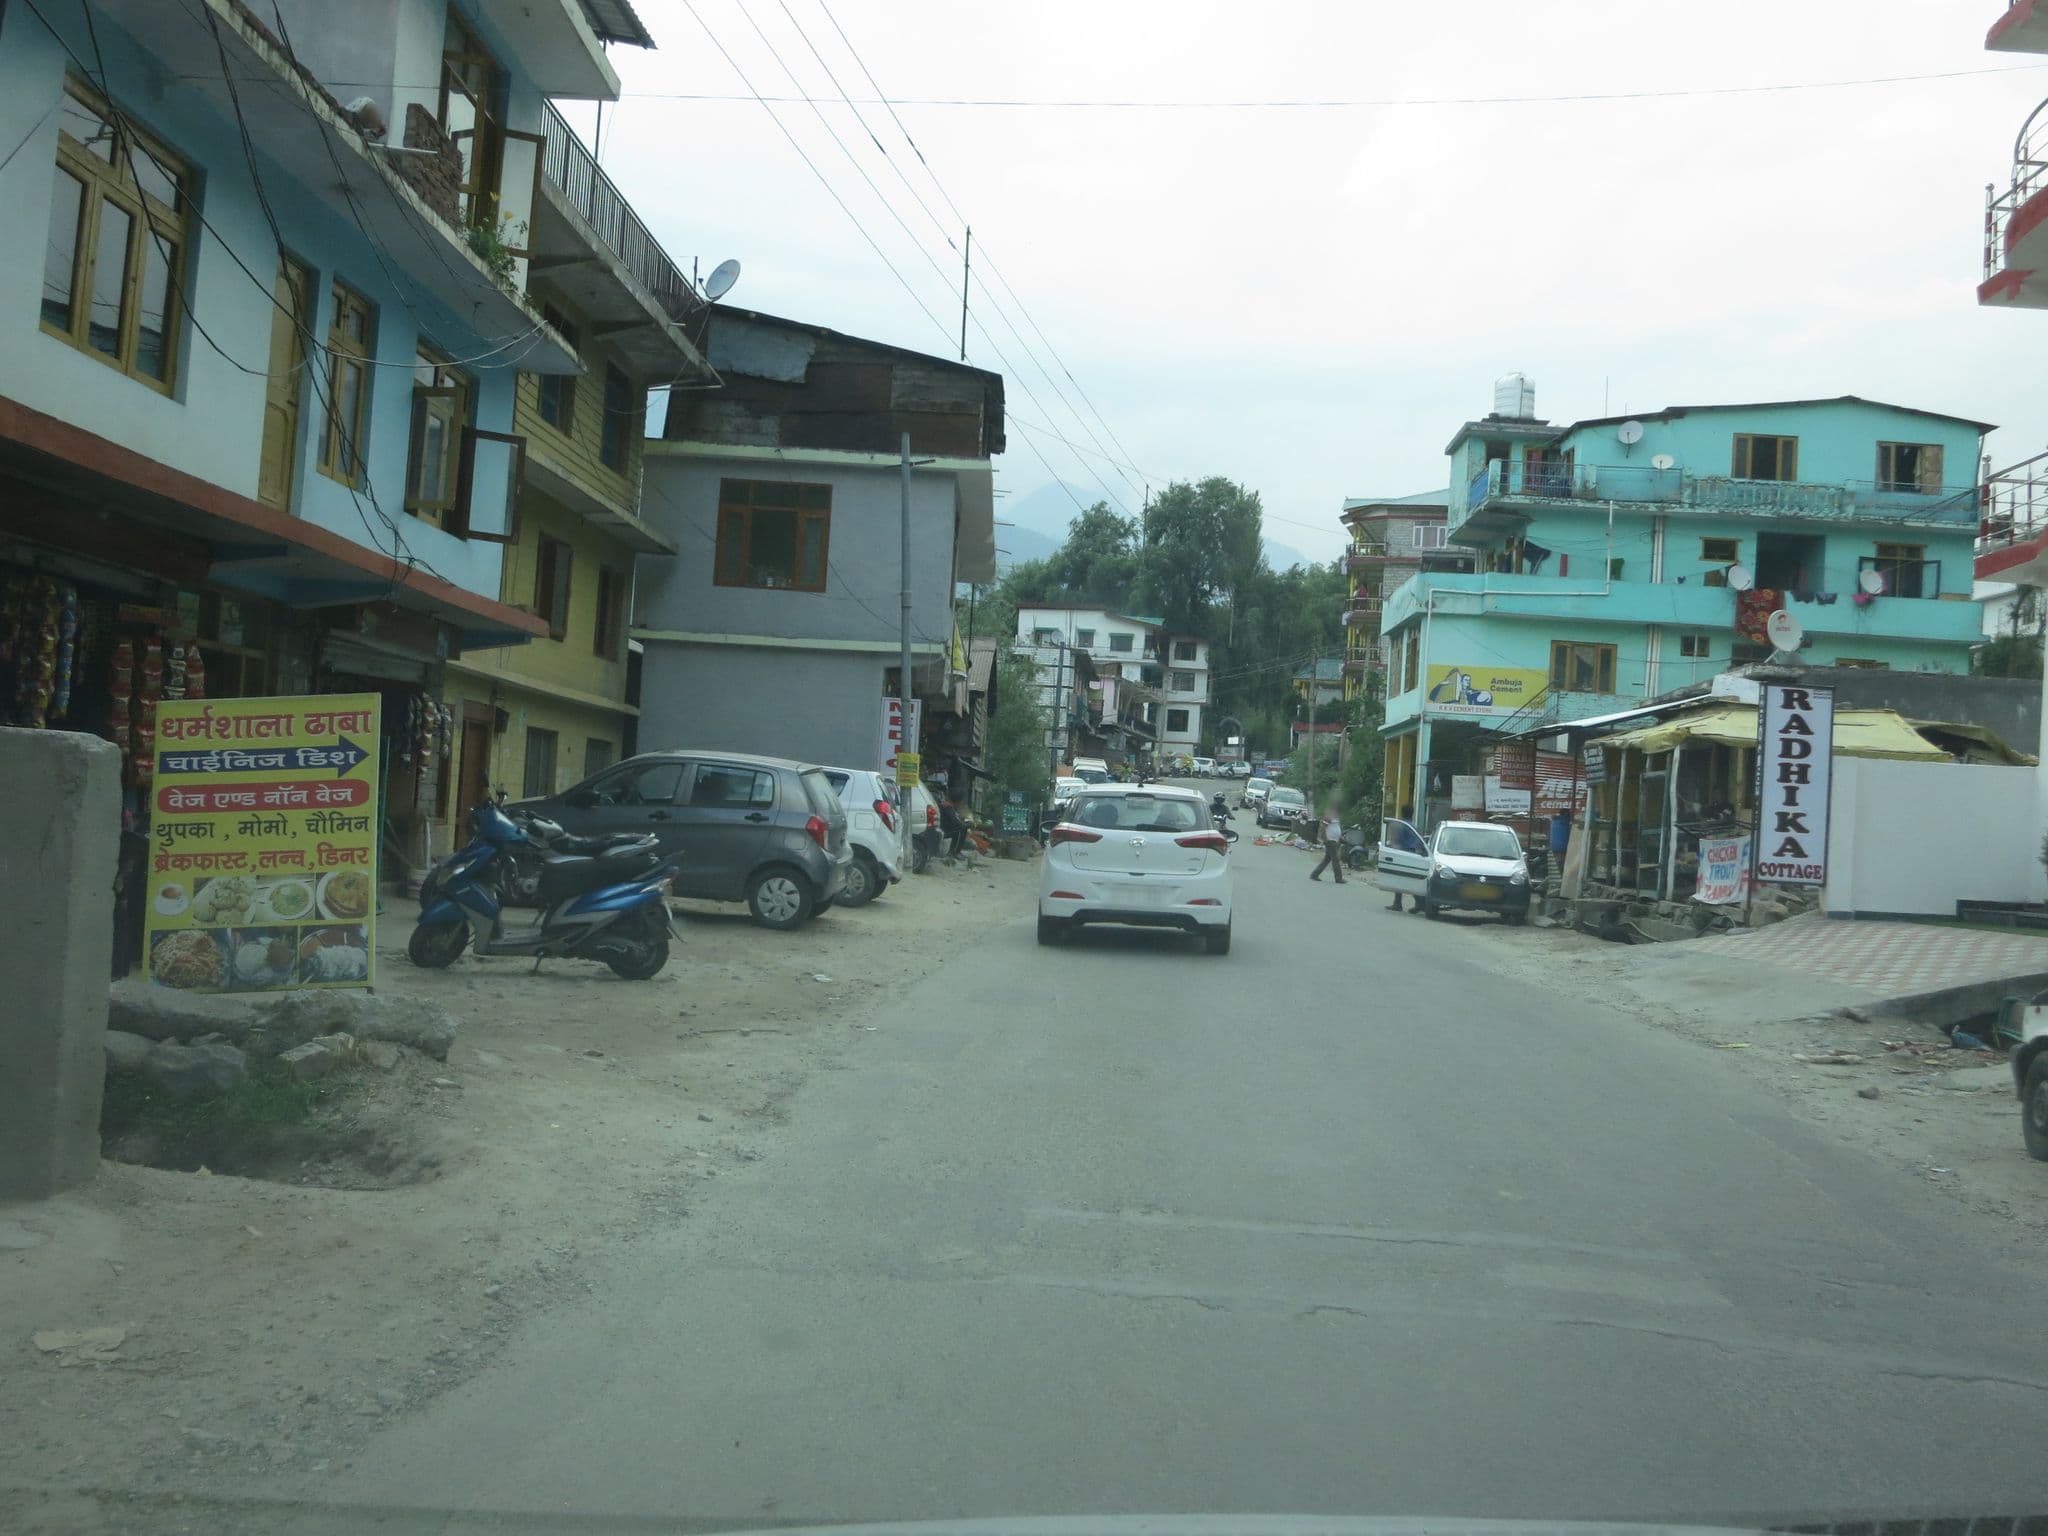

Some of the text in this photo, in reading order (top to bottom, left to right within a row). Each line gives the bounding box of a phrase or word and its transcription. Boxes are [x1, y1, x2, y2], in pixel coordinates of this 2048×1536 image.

[1490, 677, 1523, 687] Ambuja
[1490, 684, 1522, 693] Cement
[160, 705, 372, 741] धर्मशाला ढाबा
[166, 747, 358, 774] चाईनिज डिश
[1772, 688, 1815, 859] RADHIKA
[168, 783, 353, 809] वेज एण्ड नॉन वेज
[304, 810, 371, 835] चौमिन
[1758, 862, 1822, 880] COTTAGE
